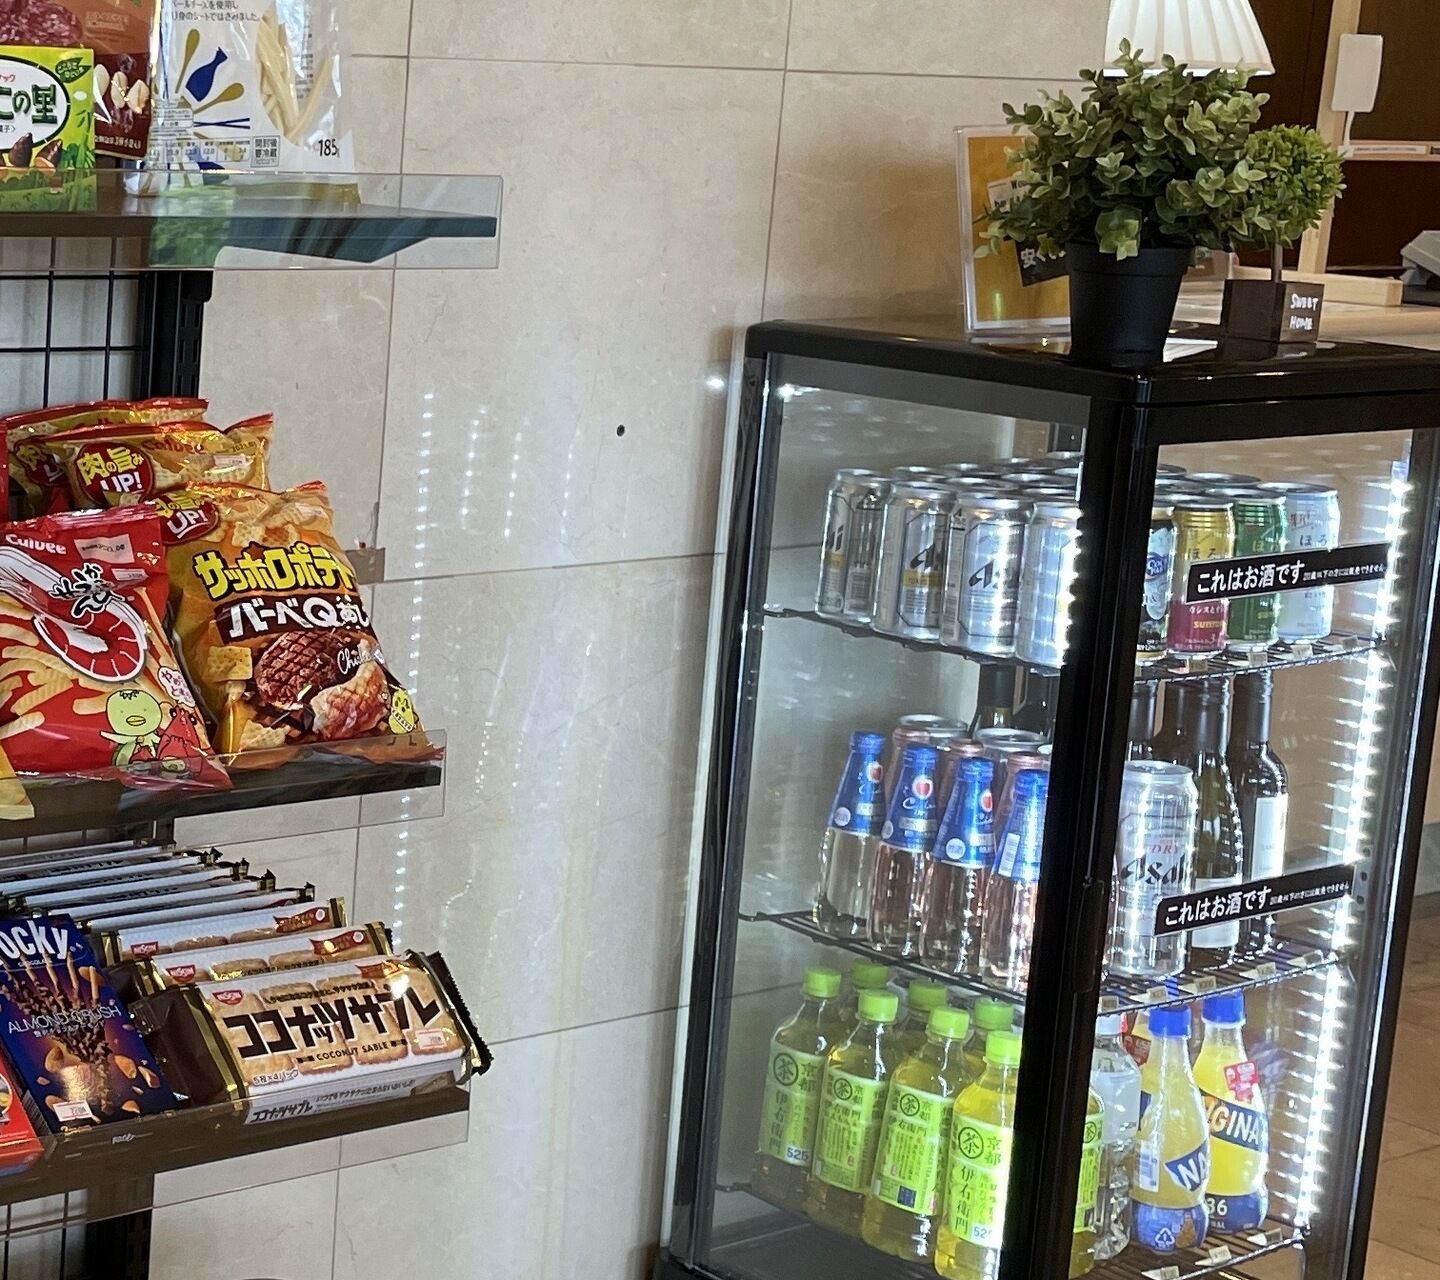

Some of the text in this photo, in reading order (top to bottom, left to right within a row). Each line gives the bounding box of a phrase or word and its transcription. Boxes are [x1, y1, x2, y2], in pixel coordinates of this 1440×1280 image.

[1290, 292, 1319, 311] SWEET
[1289, 315, 1313, 331] HOME
[1197, 560, 1306, 594] これはお酒です
[1165, 885, 1272, 926] これはお酒です
[7, 1008, 72, 1035] ALMOND
[315, 1042, 389, 1062] COCONUT SABLE
[984, 1135, 1002, 1167] 京都
